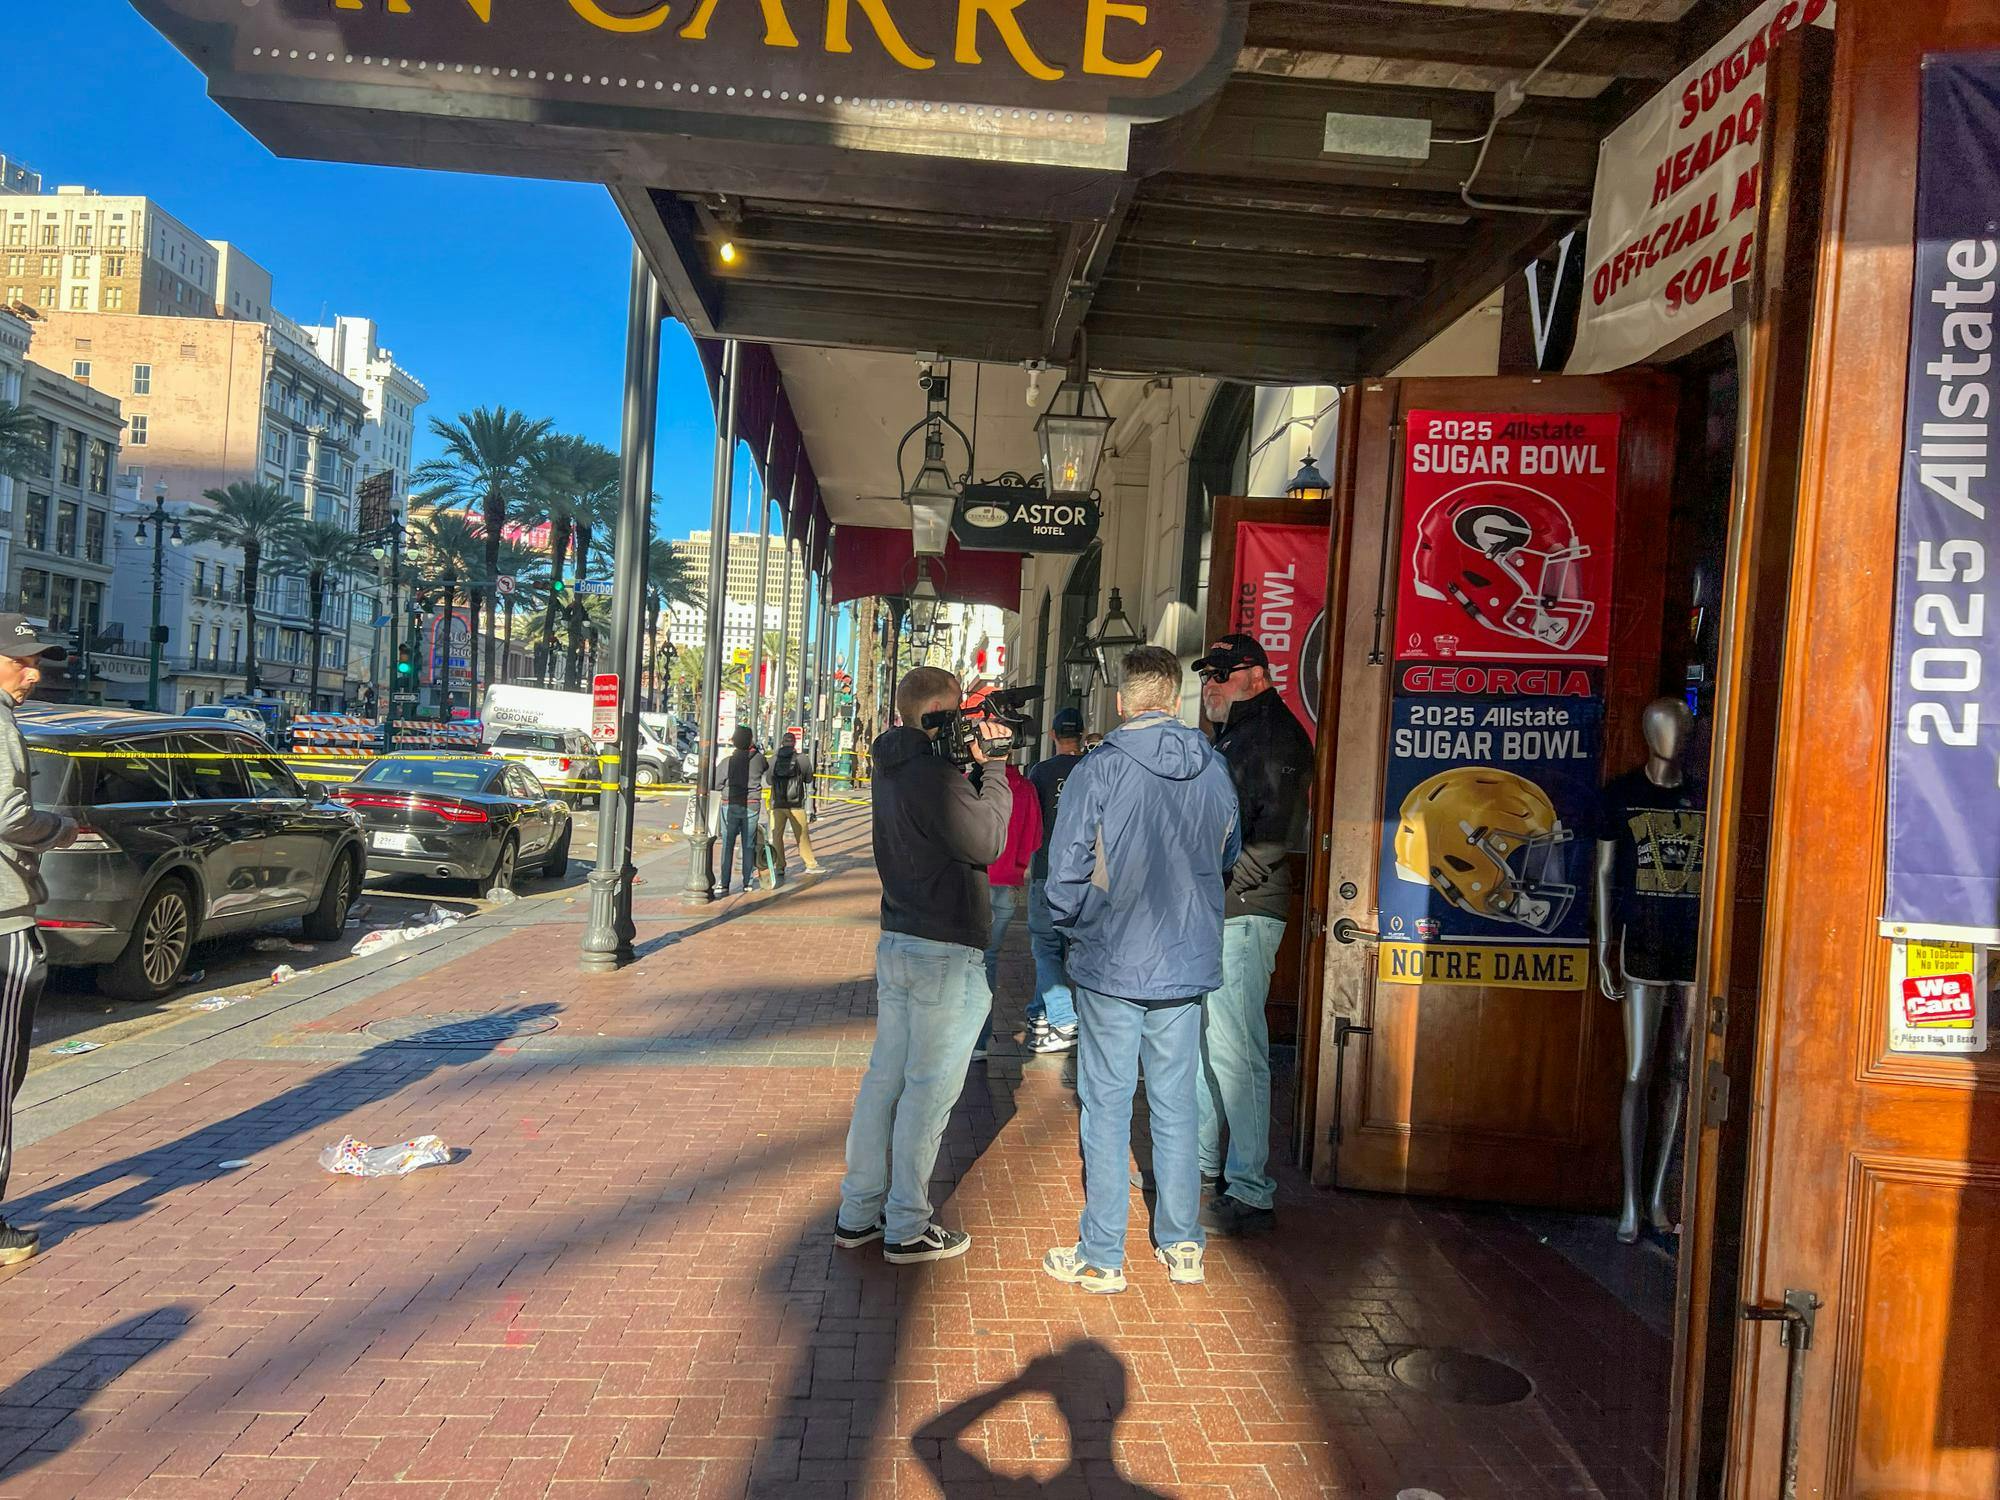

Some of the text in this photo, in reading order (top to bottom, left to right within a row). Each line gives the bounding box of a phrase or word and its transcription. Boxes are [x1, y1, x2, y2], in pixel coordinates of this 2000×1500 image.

[566, 0, 1164, 81] RRE
[1680, 1, 1799, 129] SUGAR
[1650, 92, 1765, 209] HEADQ
[1592, 192, 1719, 306] OFFICIAL
[1524, 230, 1576, 370] V
[1428, 420, 1586, 442] 2025 Allstate
[1412, 443, 1606, 475] SUGAR BOWL
[1908, 238, 1998, 747] 2025 Allstate
[1012, 504, 1086, 526] ASTOR
[1032, 525, 1066, 536] HOTEL
[1259, 563, 1296, 652] BOWL
[100, 660, 150, 676] NOUVEAU
[1402, 666, 1592, 698] GEORGIA
[496, 711, 539, 724] CORONER
[1410, 706, 1570, 727] 2025 Allstate
[1394, 728, 1588, 760] SUGAR BOWL
[1391, 948, 1575, 982] NOTRE DAME
[1916, 949, 1965, 959] No Tobacco
[1920, 959, 1960, 971] No Vapor
[1915, 978, 1961, 998] We
[1906, 994, 1971, 1015] Card
